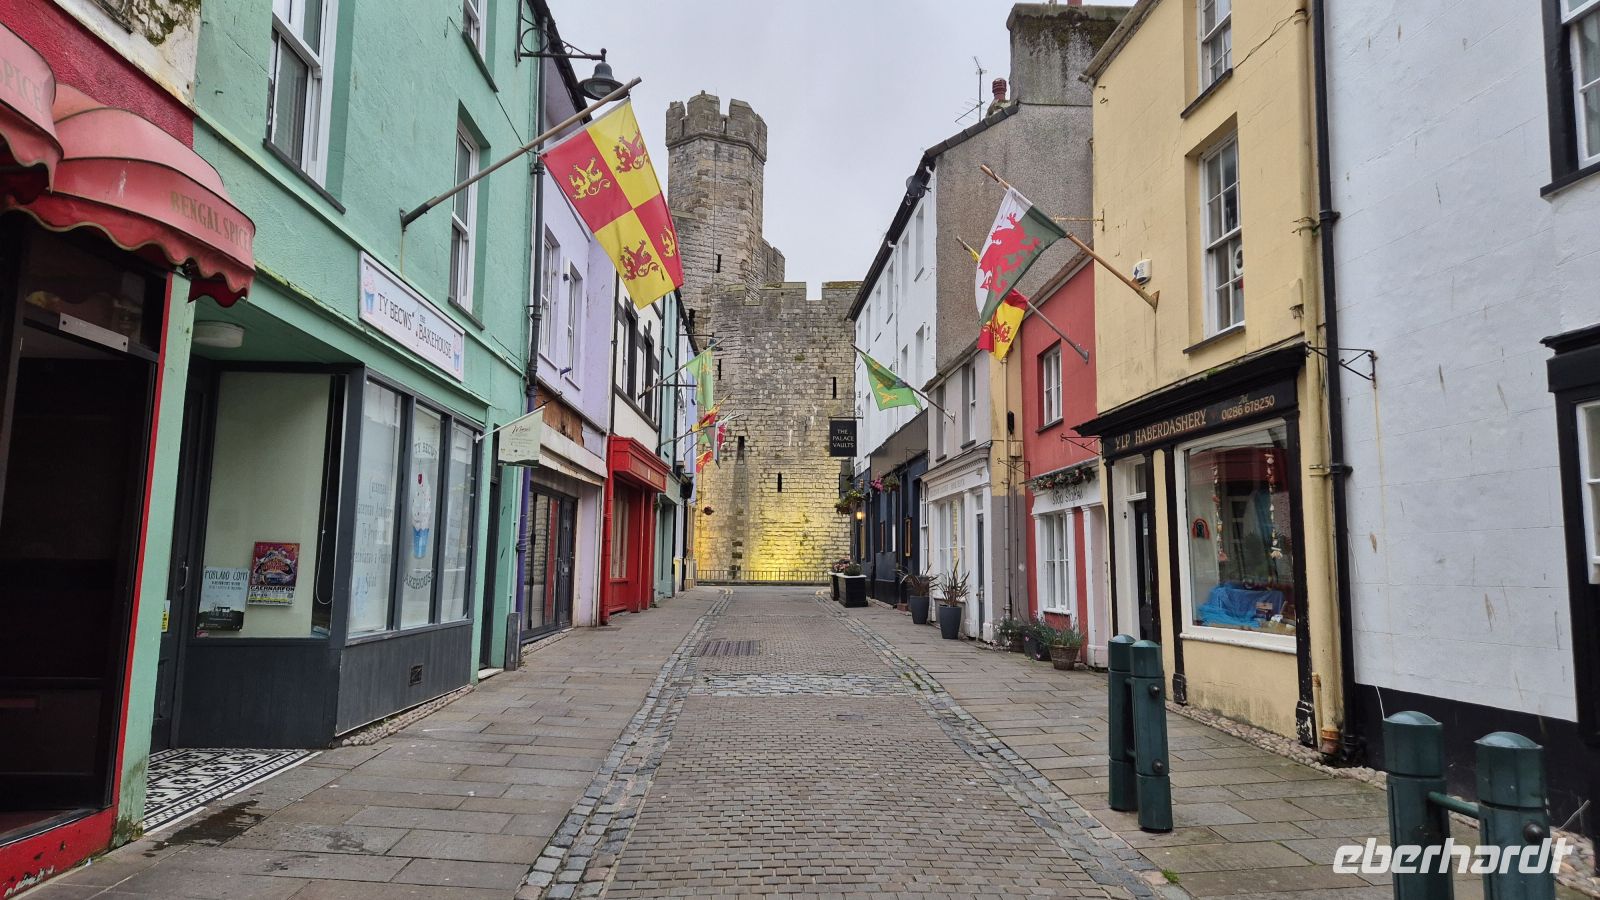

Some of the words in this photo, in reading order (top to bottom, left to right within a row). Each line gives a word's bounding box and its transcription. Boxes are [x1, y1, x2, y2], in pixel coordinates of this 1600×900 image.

[170, 191, 222, 235] BENGAL
[418, 323, 452, 359] BAKEHOUSE
[1135, 408, 1207, 445] HABERDASHERY
[1221, 404, 1243, 421] 01286
